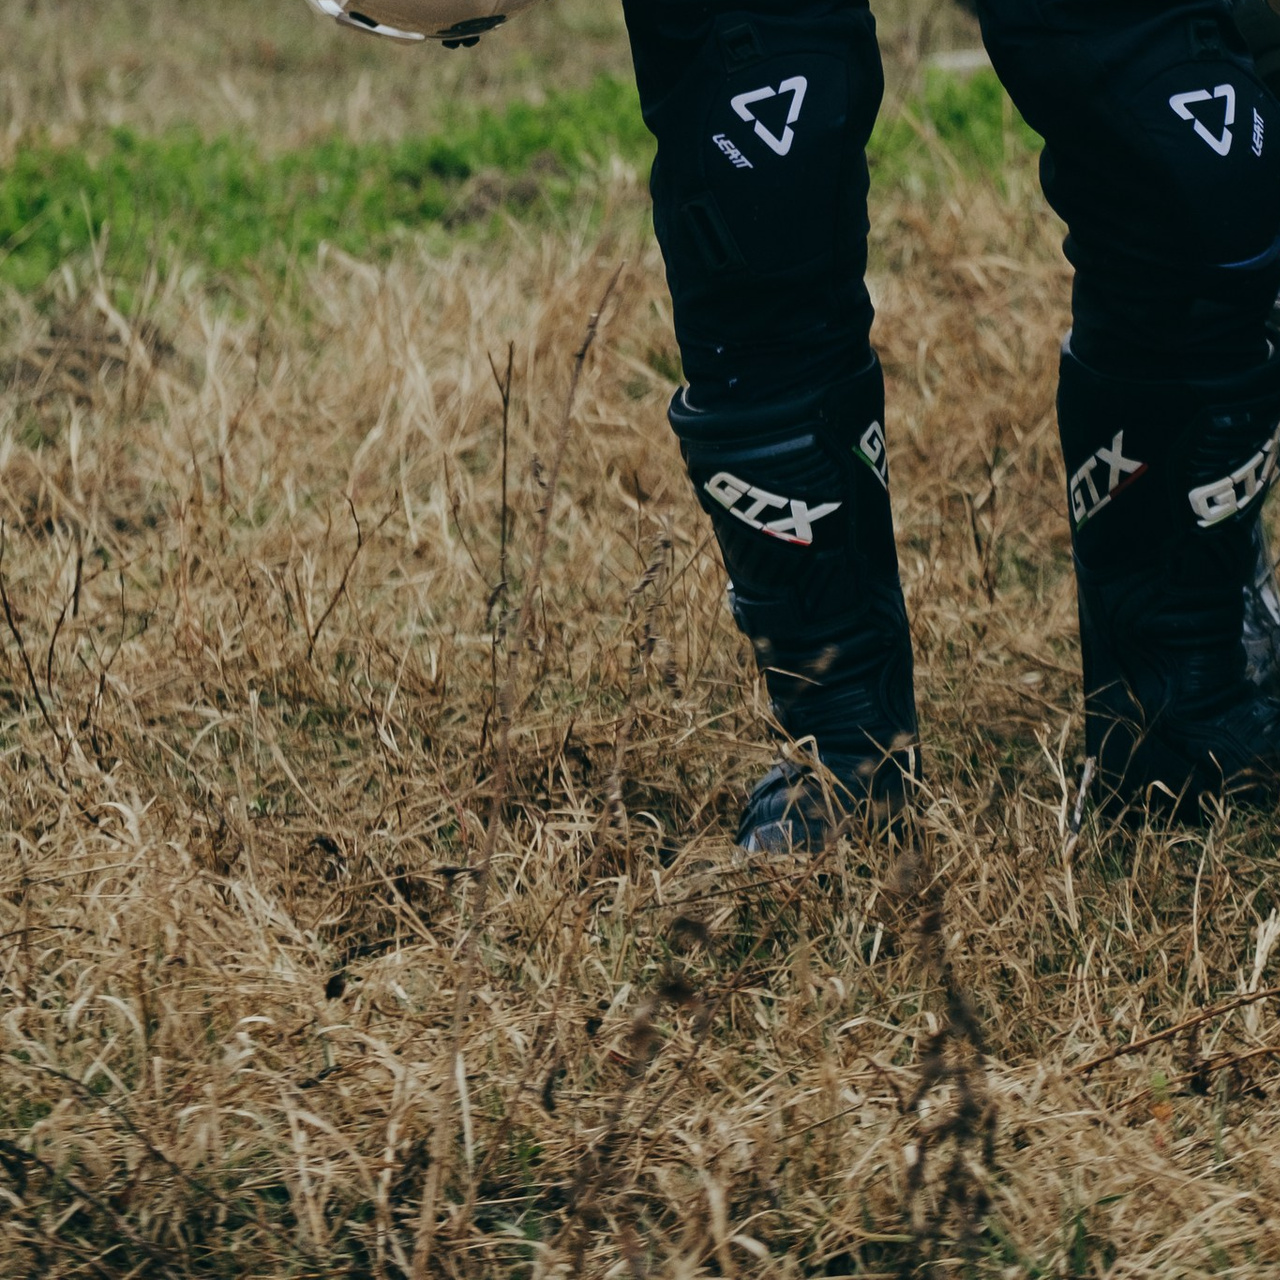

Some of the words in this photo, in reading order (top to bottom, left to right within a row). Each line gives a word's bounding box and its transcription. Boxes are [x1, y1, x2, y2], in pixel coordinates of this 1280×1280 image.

[712, 134, 753, 168] LEATT
[1251, 107, 1265, 157] LEATT
[704, 471, 843, 546] GTX
[1070, 429, 1147, 527] GTX
